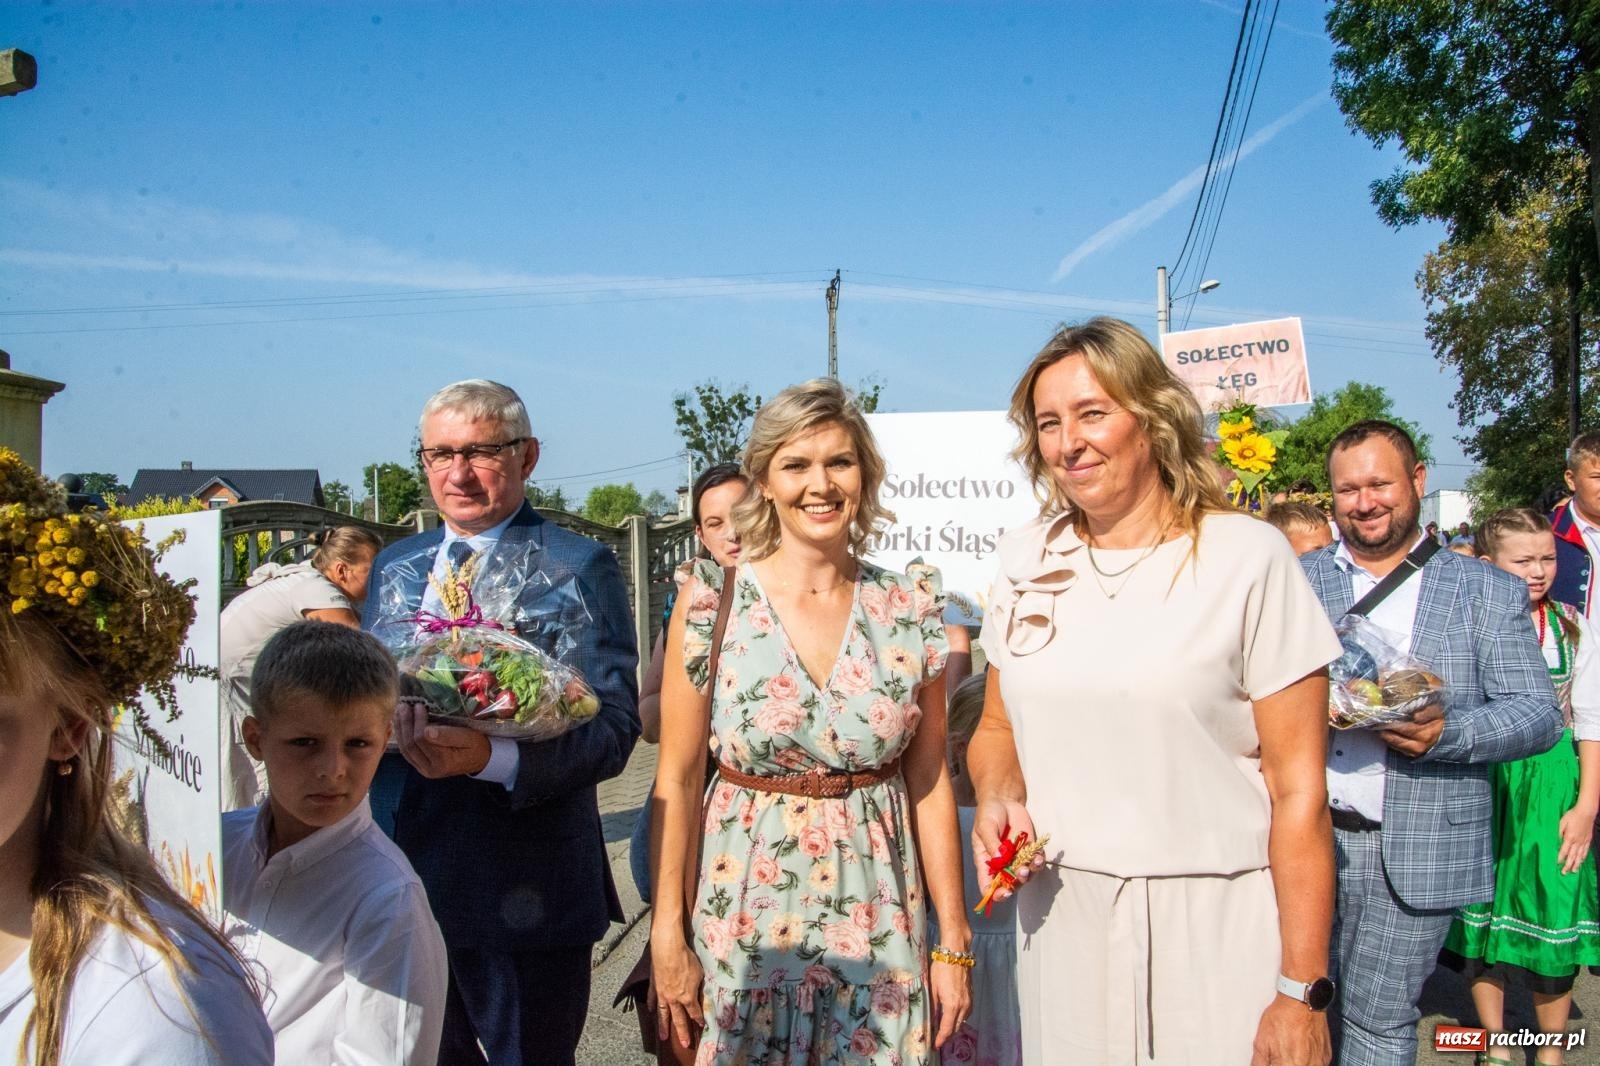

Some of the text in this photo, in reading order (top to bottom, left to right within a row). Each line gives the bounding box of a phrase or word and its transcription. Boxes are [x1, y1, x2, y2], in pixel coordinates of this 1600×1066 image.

[1176, 338, 1290, 365] SOŁECTWO
[1215, 372, 1258, 392] ŁĘG
[882, 472, 1015, 500] Sołectwo
[938, 520, 1005, 560] Śląs
